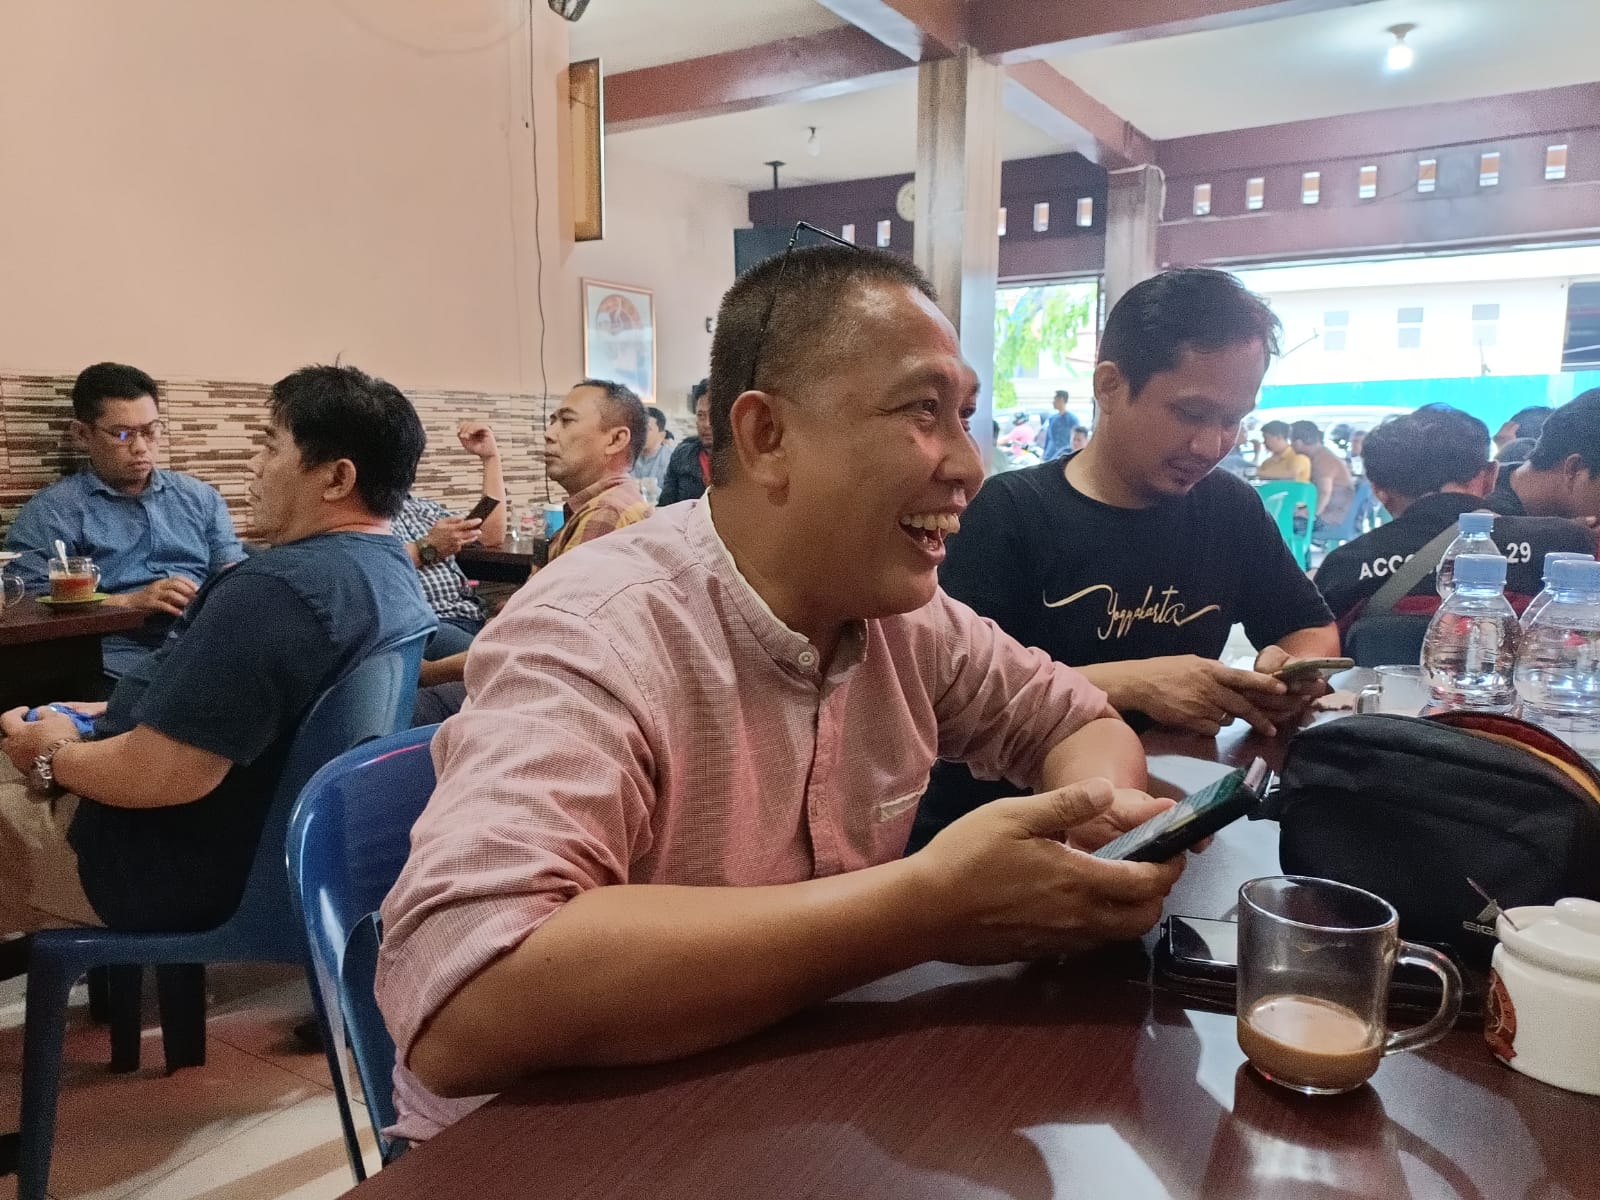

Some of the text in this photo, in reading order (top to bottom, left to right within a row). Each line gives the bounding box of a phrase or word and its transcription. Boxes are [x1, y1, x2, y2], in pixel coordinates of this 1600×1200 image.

[1359, 542, 1531, 580] ACC 29
[1043, 584, 1221, 640] Yogyakarta
[1462, 920, 1496, 937] EIG
